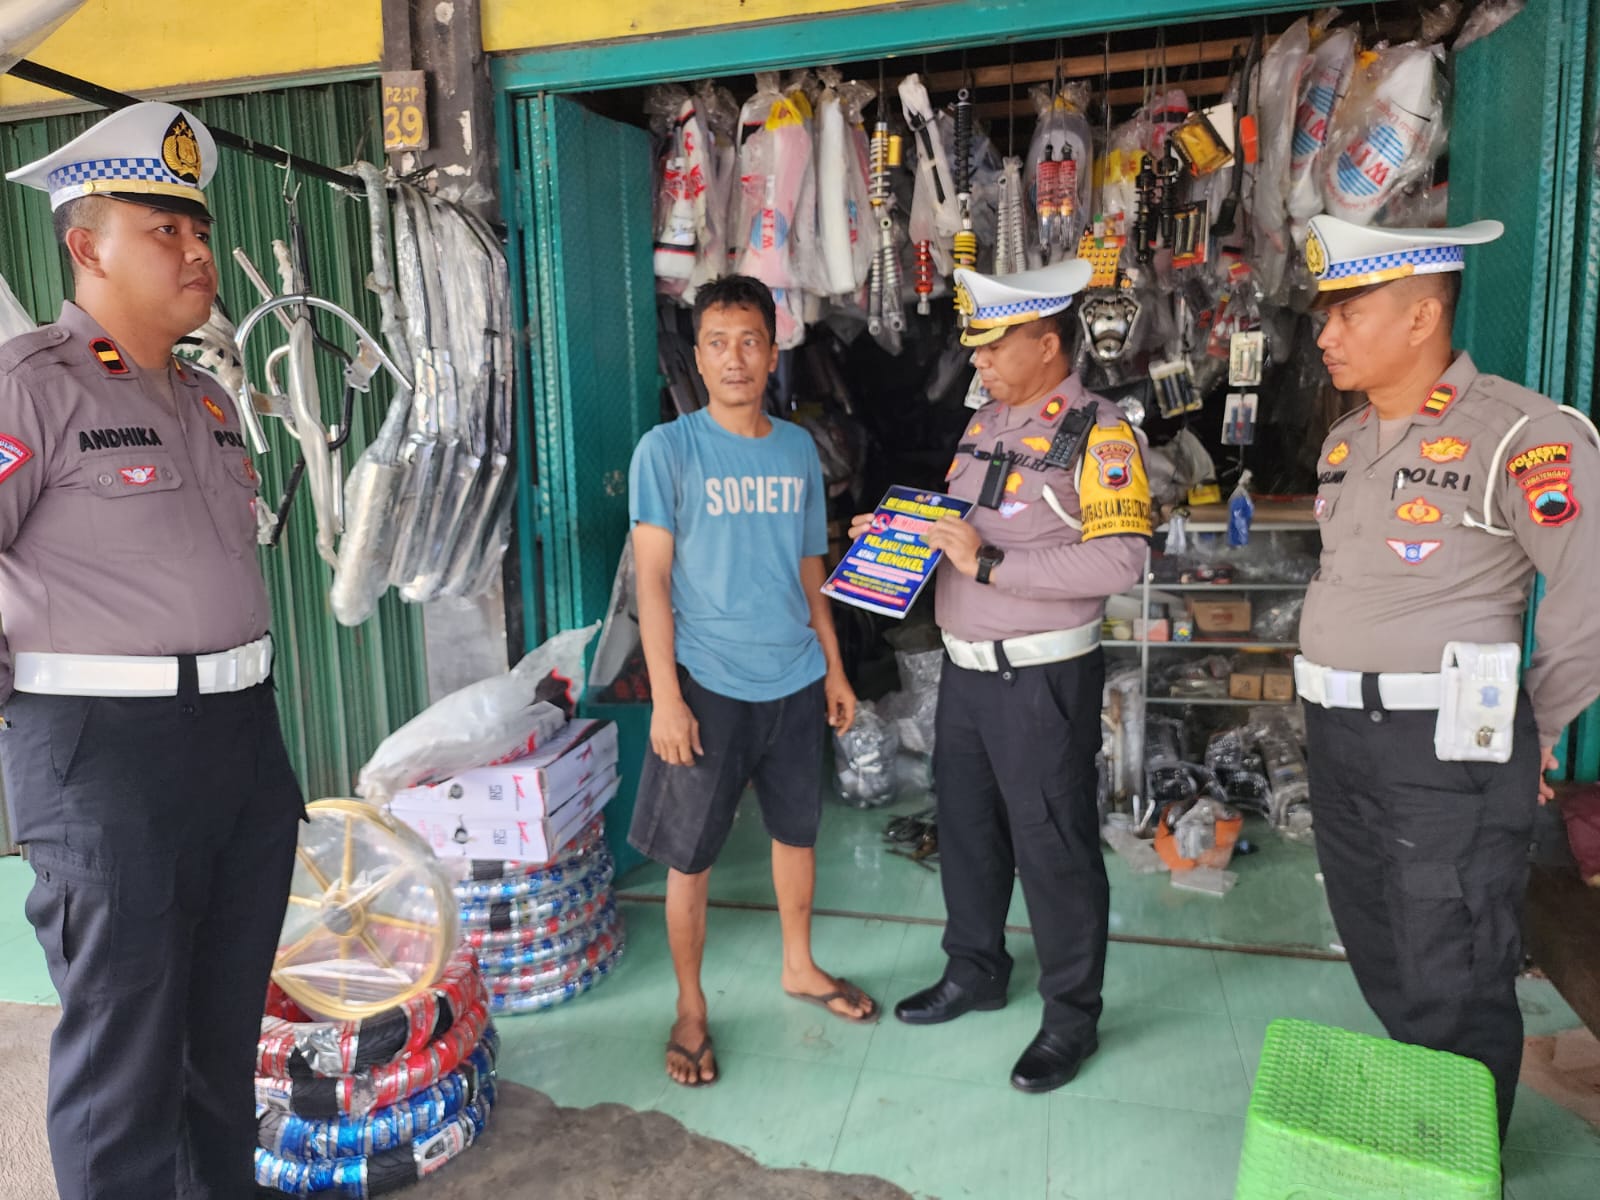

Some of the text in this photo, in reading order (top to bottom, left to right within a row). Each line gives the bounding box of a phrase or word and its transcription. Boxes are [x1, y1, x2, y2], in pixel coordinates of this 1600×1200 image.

[79, 427, 163, 452] ANDHIKA
[1394, 467, 1471, 492] POLRI
[705, 476, 804, 516] SOCIETY
